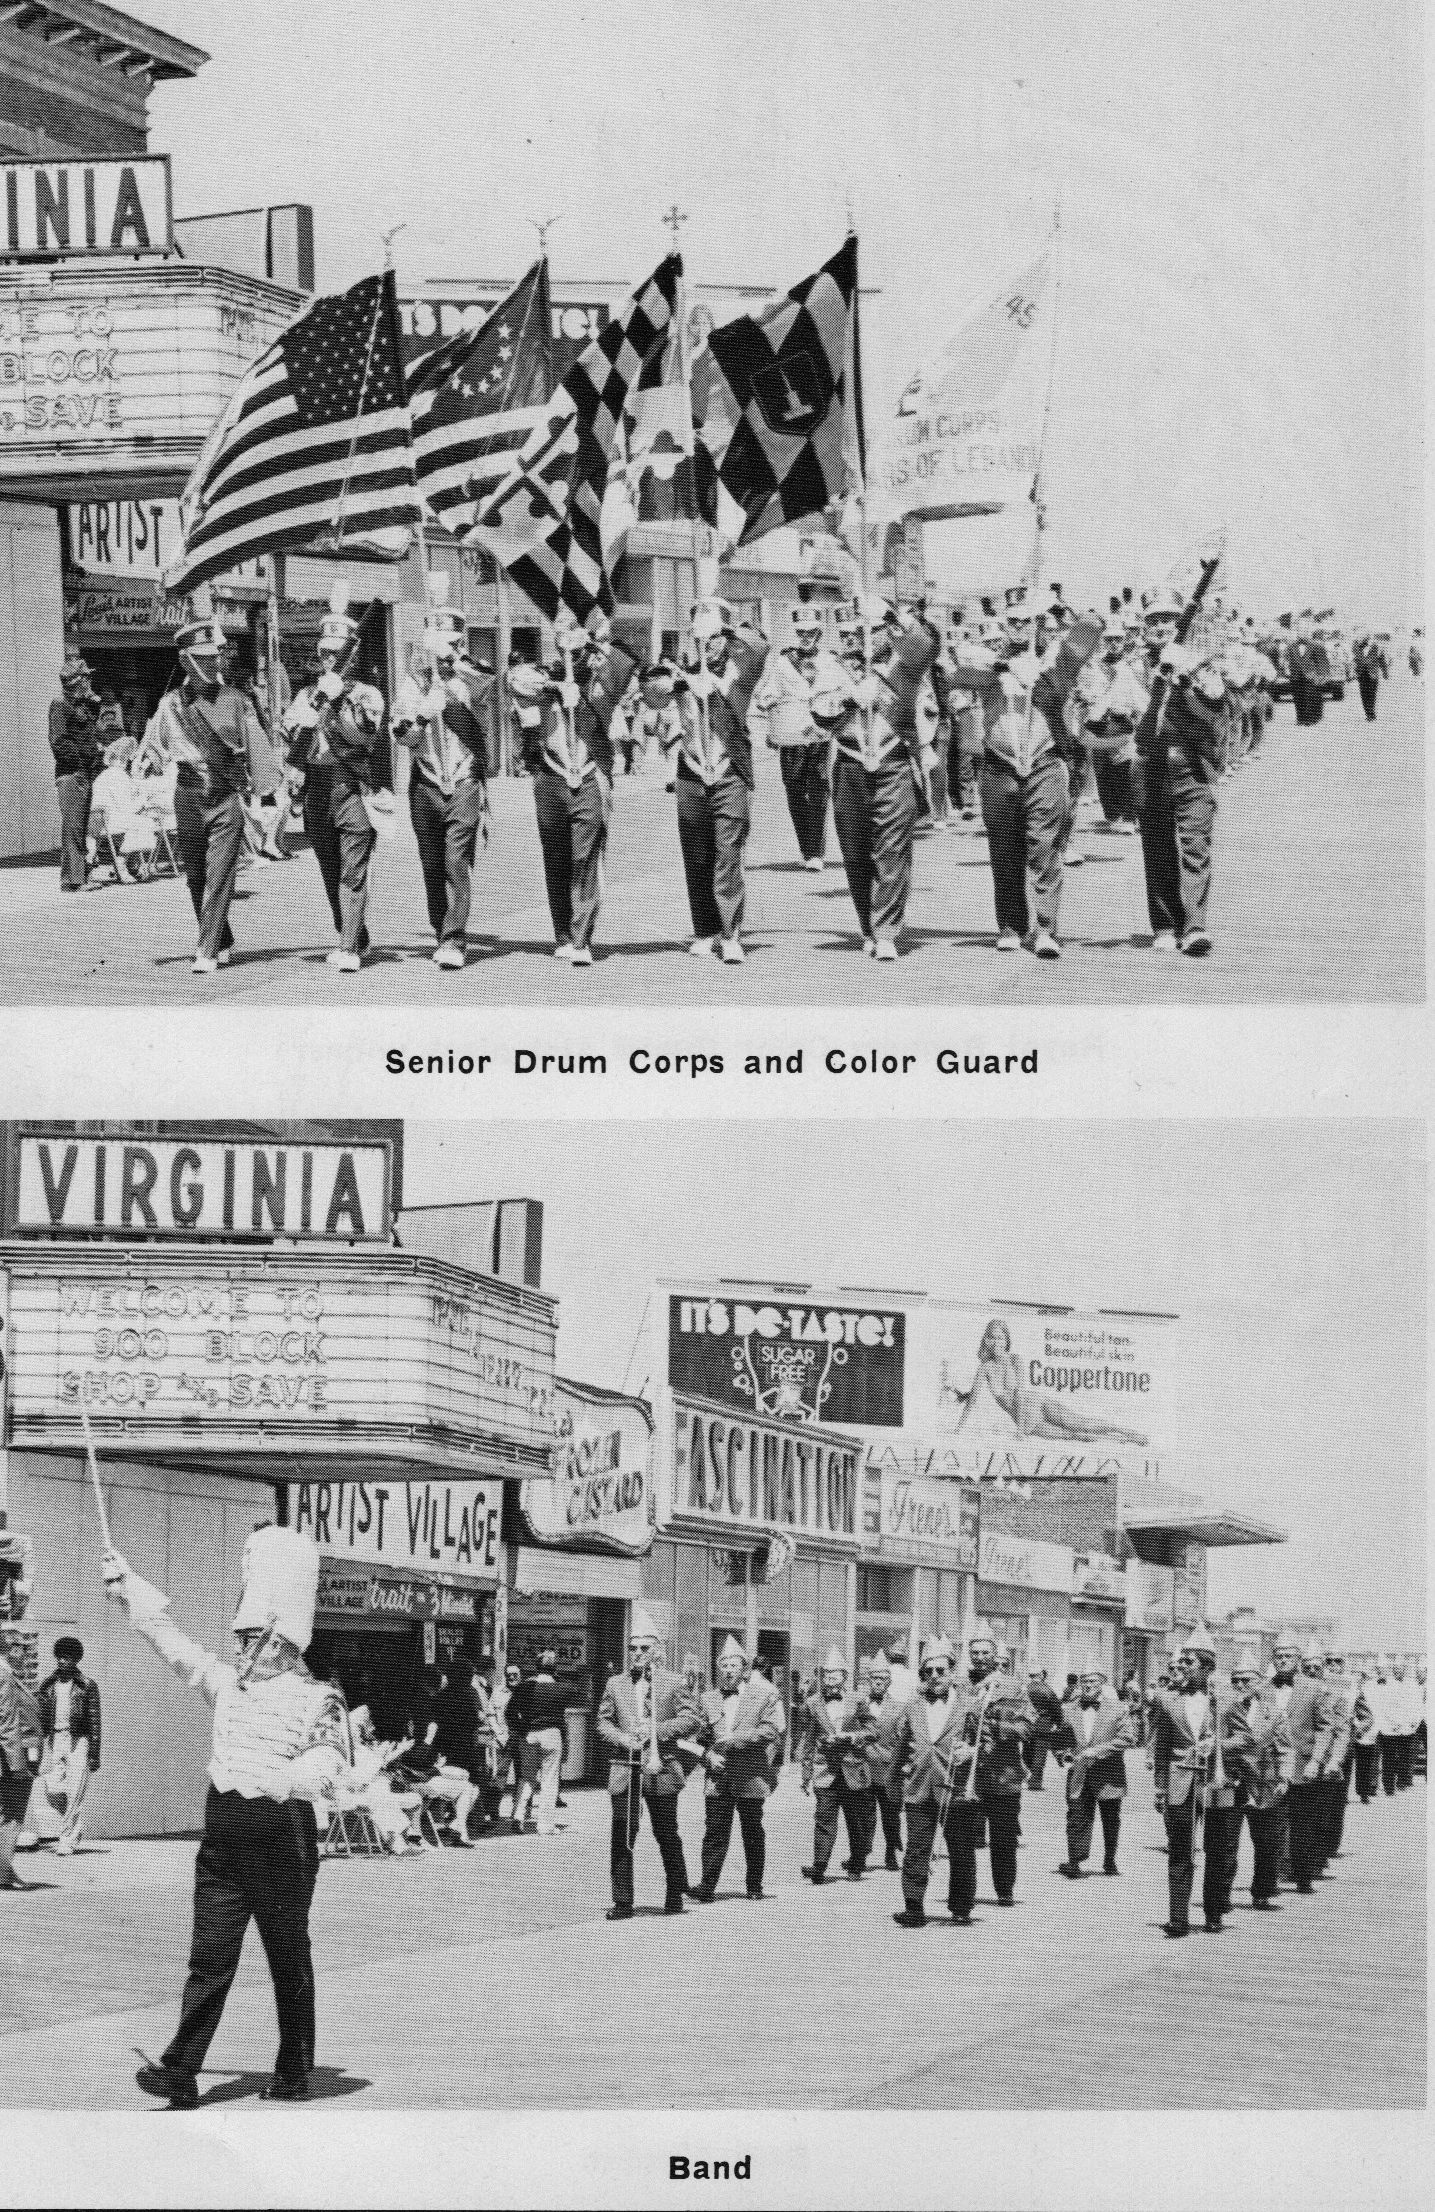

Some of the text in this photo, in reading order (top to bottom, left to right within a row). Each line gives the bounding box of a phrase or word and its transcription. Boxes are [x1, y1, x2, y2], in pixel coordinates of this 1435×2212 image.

[65, 304, 115, 341] TO
[0, 349, 119, 385] BLOCK
[25, 393, 122, 430] SAVE
[916, 449, 943, 479] OF
[79, 500, 163, 567] ARTIST
[105, 613, 150, 626] VILLAGE
[115, 597, 153, 609] ARTIST
[37, 1144, 365, 1235] VIRGINIA
[60, 1284, 324, 1321] WELCOME TO
[681, 1299, 730, 1336] IT'S
[95, 1328, 327, 1364] 900 BLOCK
[1044, 1328, 1105, 1344] Beautiful
[1044, 1343, 1135, 1361] Beautiful skin
[761, 1346, 815, 1365] SUGAR
[770, 1364, 806, 1382] FREE
[1029, 1360, 1150, 1393] Coppertone
[62, 1371, 161, 1407] SHOP
[230, 1374, 328, 1410] SAVE
[297, 1481, 497, 1566] ARTIST VILLAGE
[319, 1595, 364, 1608] VILLAGE
[330, 1578, 368, 1592] ARTIST
